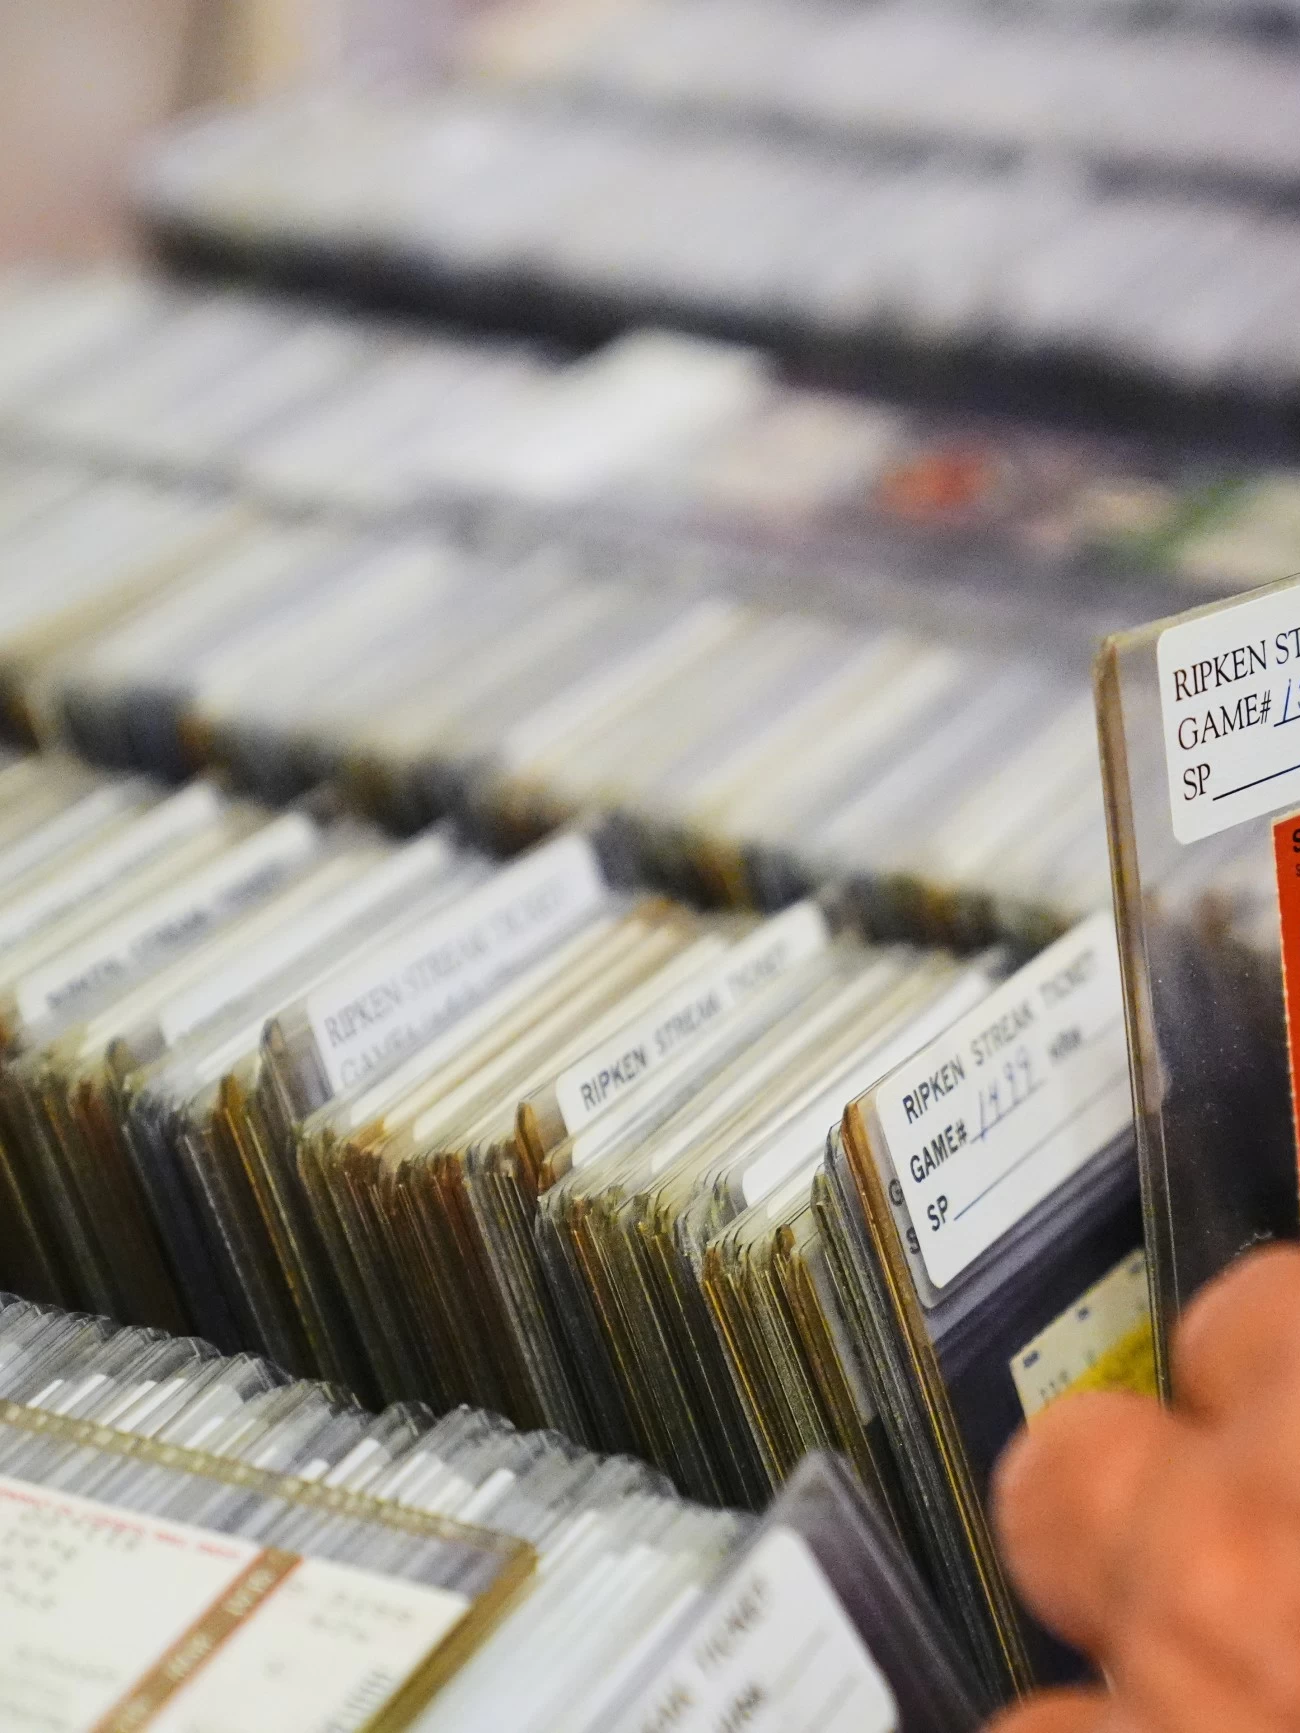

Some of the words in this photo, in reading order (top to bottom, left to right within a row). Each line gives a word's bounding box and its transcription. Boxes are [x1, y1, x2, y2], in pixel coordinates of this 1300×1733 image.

[1173, 640, 1268, 702] RIPKEN
[1177, 690, 1272, 751] GAME#
[1182, 763, 1212, 802] SP
[323, 976, 404, 1049] RIPKEN
[579, 1043, 649, 1112] RIPKEN
[652, 989, 725, 1058] STREAK
[902, 1054, 968, 1125] RIPKEN
[970, 1000, 1037, 1067] STREAK
[909, 1117, 969, 1184] GAME#
[926, 1194, 950, 1233] SP
